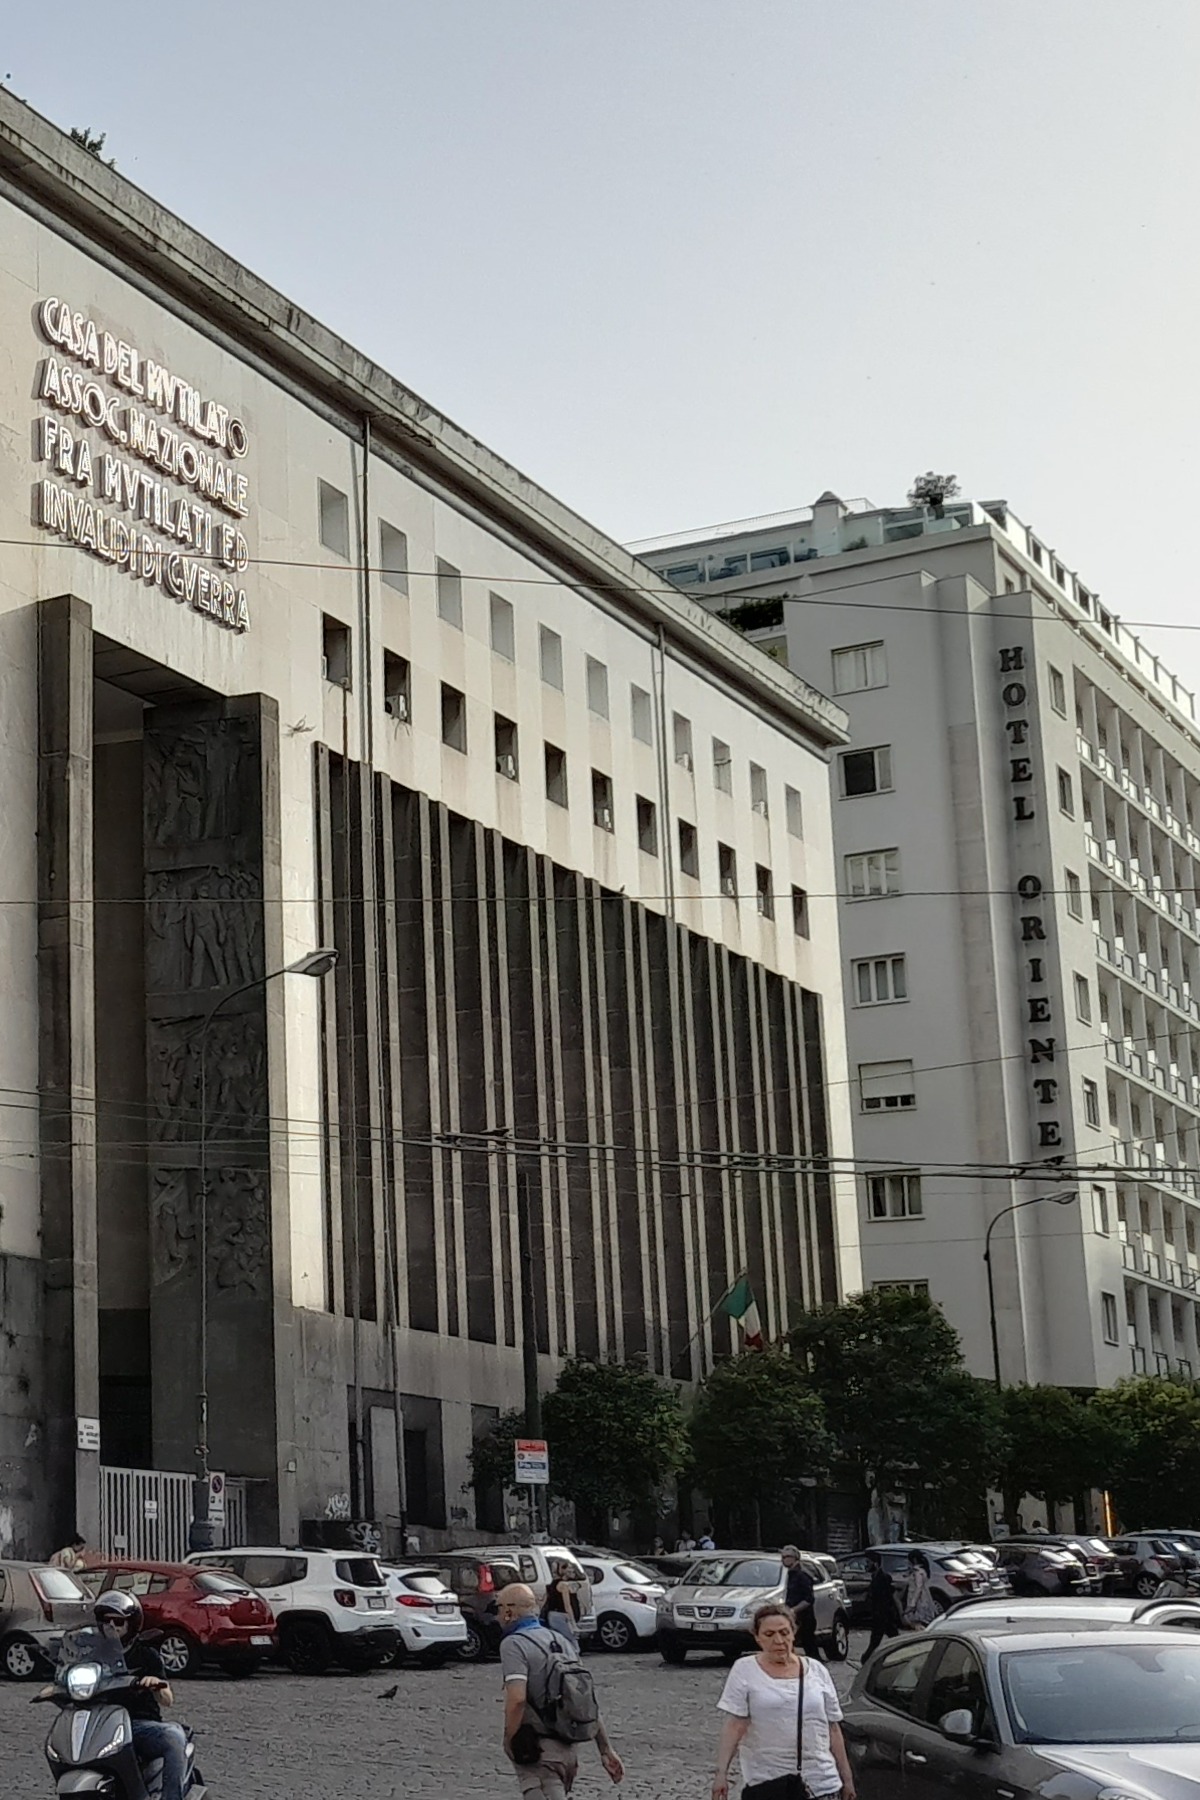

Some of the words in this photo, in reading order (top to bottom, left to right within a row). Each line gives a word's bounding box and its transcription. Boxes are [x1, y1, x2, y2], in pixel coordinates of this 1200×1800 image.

[42, 297, 100, 368] CASA
[104, 331, 144, 395] DEL
[44, 357, 127, 443] ASSOC.
[130, 407, 249, 517] NAZIONALE
[45, 415, 94, 486] FRA
[223, 523, 249, 573] ED
[43, 479, 137, 572] INVALIDI
[142, 534, 163, 585] DI
[1000, 645, 1036, 822] HOTEL
[1017, 875, 1062, 1147] ORIENTE
